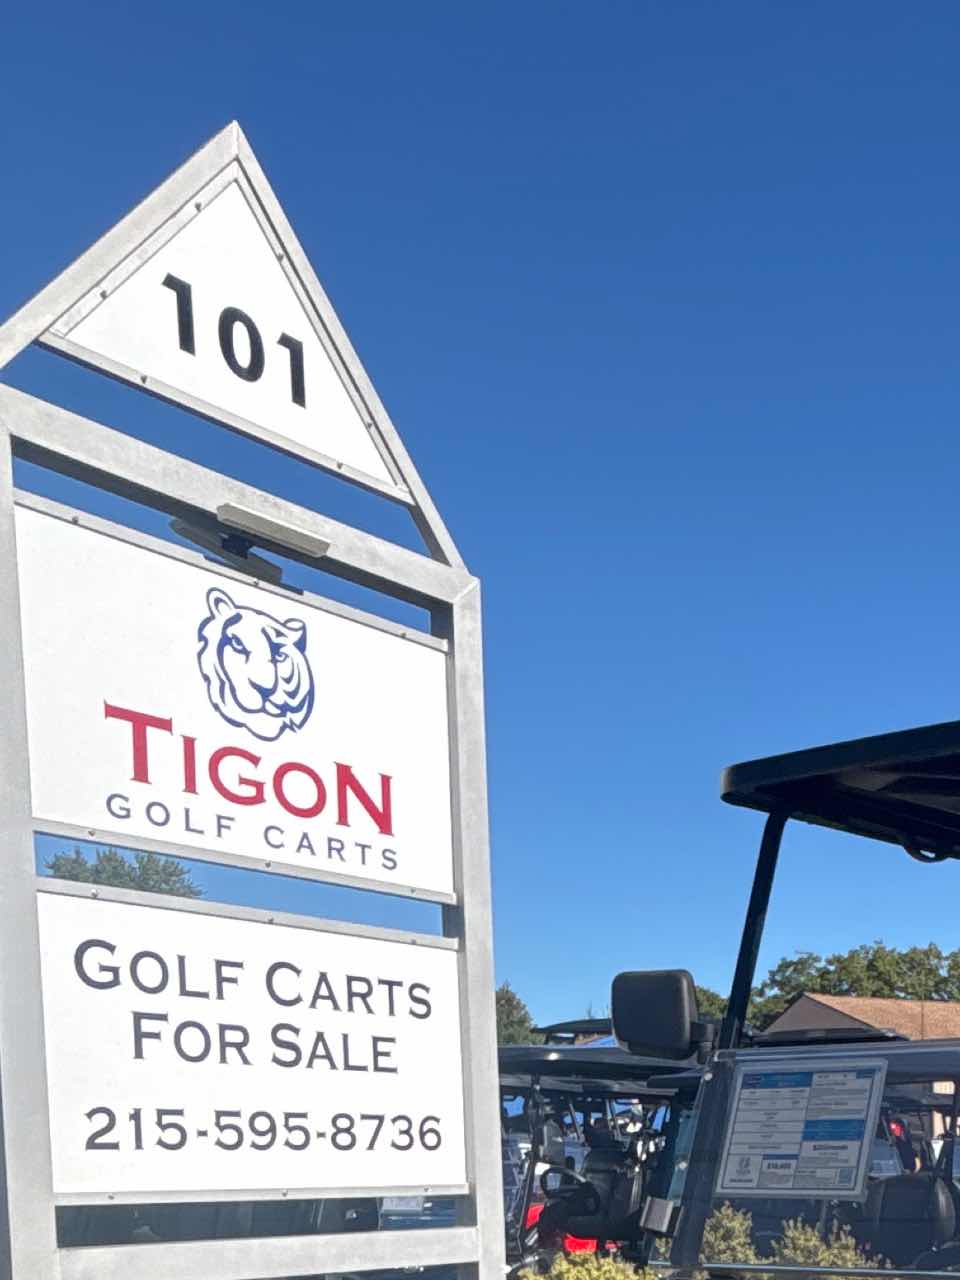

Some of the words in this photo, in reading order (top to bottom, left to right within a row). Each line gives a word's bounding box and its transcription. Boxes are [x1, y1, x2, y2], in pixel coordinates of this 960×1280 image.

[161, 272, 306, 409] 101
[103, 700, 394, 837] TIGON
[106, 793, 236, 838] GOLF
[263, 825, 398, 871] CARTS
[73, 938, 244, 1001] GOLF
[265, 961, 433, 1020] CARTS
[132, 1011, 252, 1066] FOR
[270, 1022, 399, 1074] SALE
[84, 1106, 443, 1152] 215-595-8736
